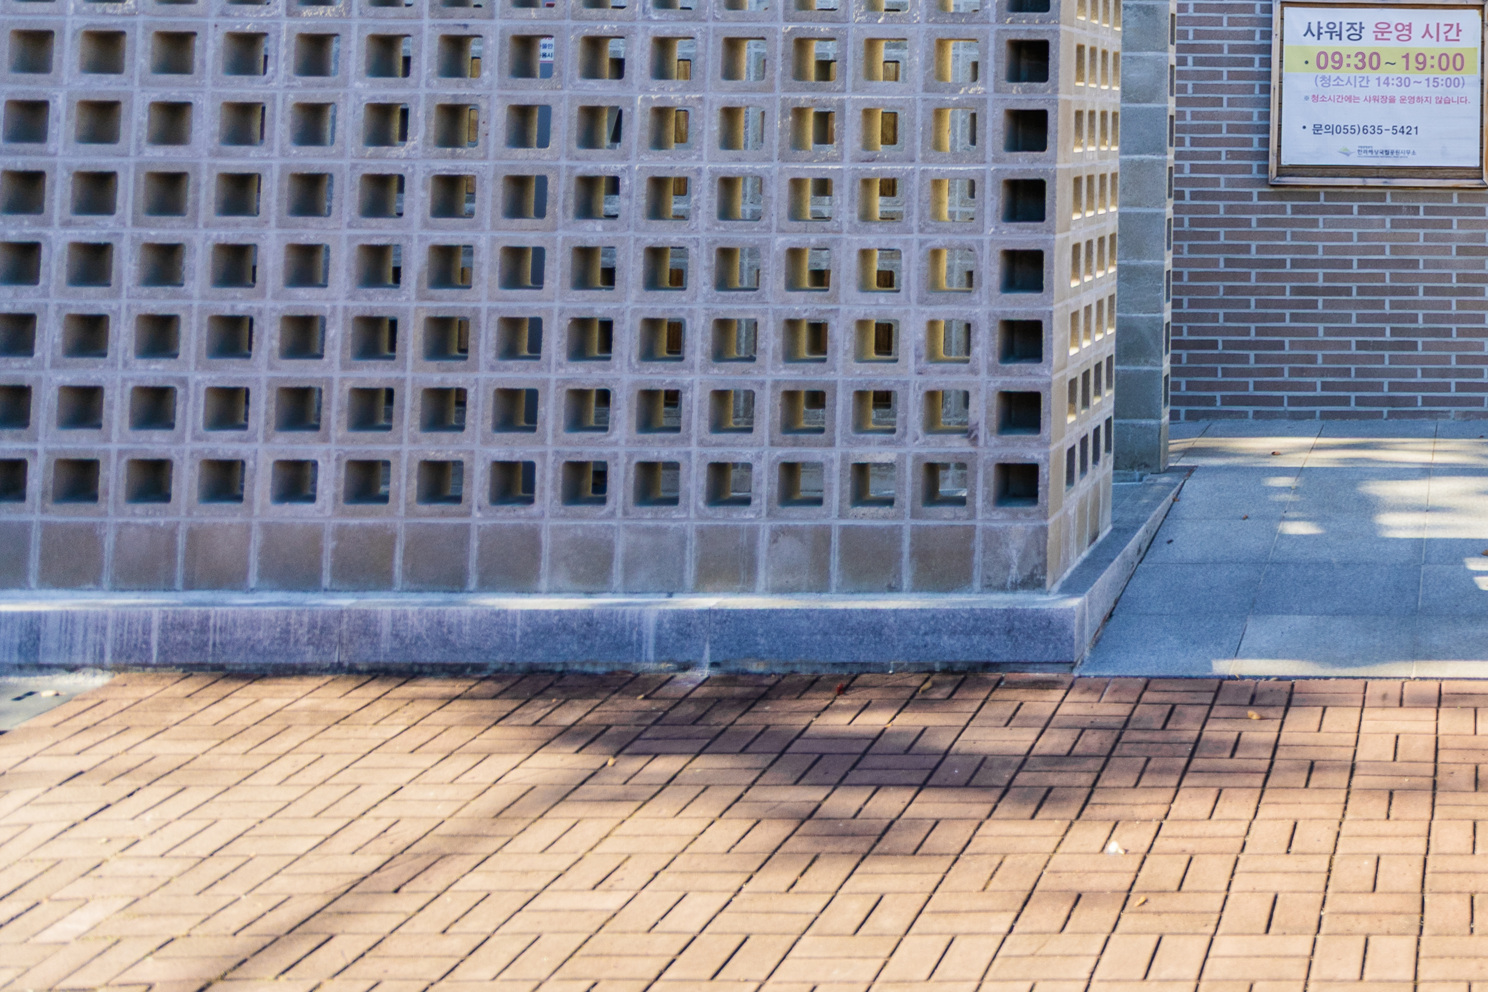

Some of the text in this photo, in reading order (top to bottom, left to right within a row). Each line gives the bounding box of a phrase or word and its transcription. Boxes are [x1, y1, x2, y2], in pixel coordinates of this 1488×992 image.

[1303, 21, 1463, 42] 샤워장 운영 시간
[1315, 50, 1465, 72] 09:30~19:00
[1314, 75, 1466, 89] (청소시간 14:30~15:00)
[1311, 94, 1361, 104] 청소시간에는
[1399, 95, 1433, 105] 운영하지
[1311, 123, 1420, 136] 문의055)635-5421
